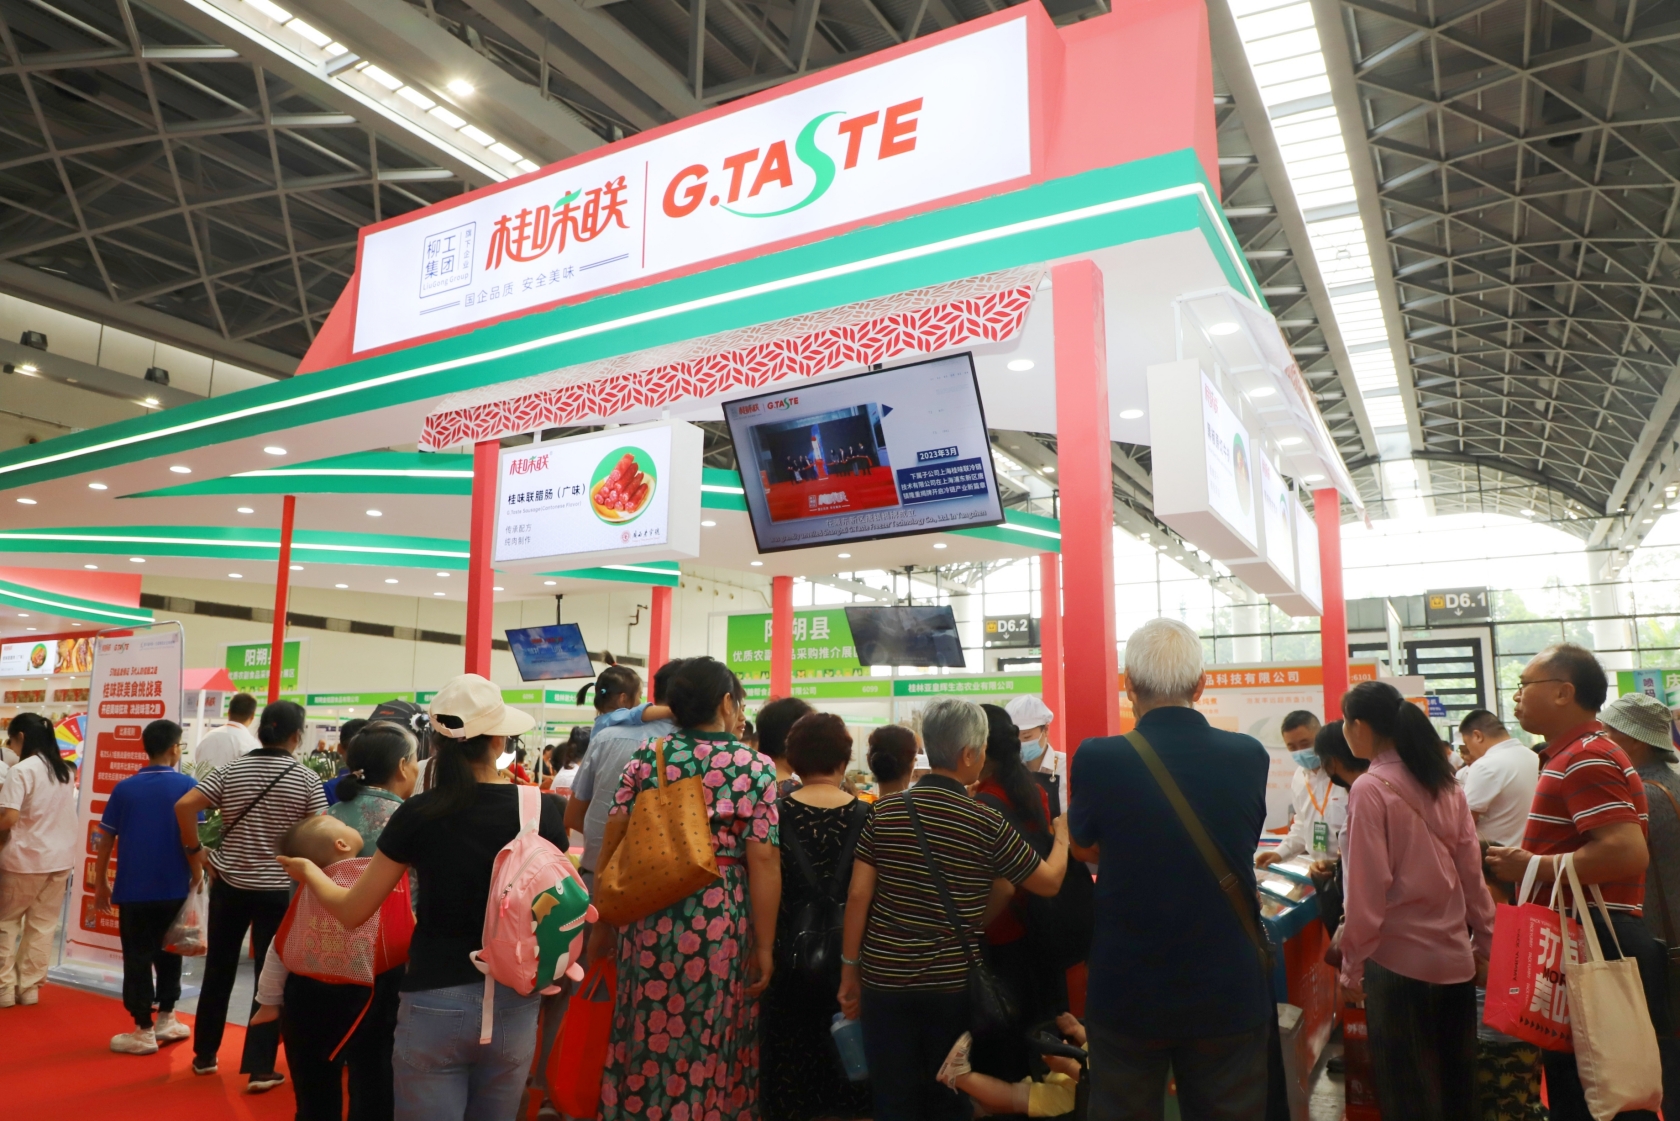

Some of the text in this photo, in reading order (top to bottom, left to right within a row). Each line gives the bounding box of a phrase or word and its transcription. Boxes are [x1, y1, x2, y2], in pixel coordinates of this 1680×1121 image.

[662, 97, 924, 218] G.TASTE
[484, 175, 631, 272] 桂味联
[427, 234, 457, 260] 柳工
[462, 228, 473, 270] 旗下企业
[424, 254, 455, 280] 集团
[423, 272, 469, 291] LiuGong Group
[465, 264, 575, 308] 国企品质 安全美味
[767, 396, 799, 411] G.TASTE
[919, 447, 957, 460] 2023年3月
[509, 453, 550, 476] 桂味联
[505, 524, 532, 534] 传承配方
[1445, 592, 1487, 609] D6.1
[997, 619, 1028, 633] D6.2
[244, 648, 271, 667] 阳朔
[103, 680, 163, 699] 桂味联美食挑战赛
